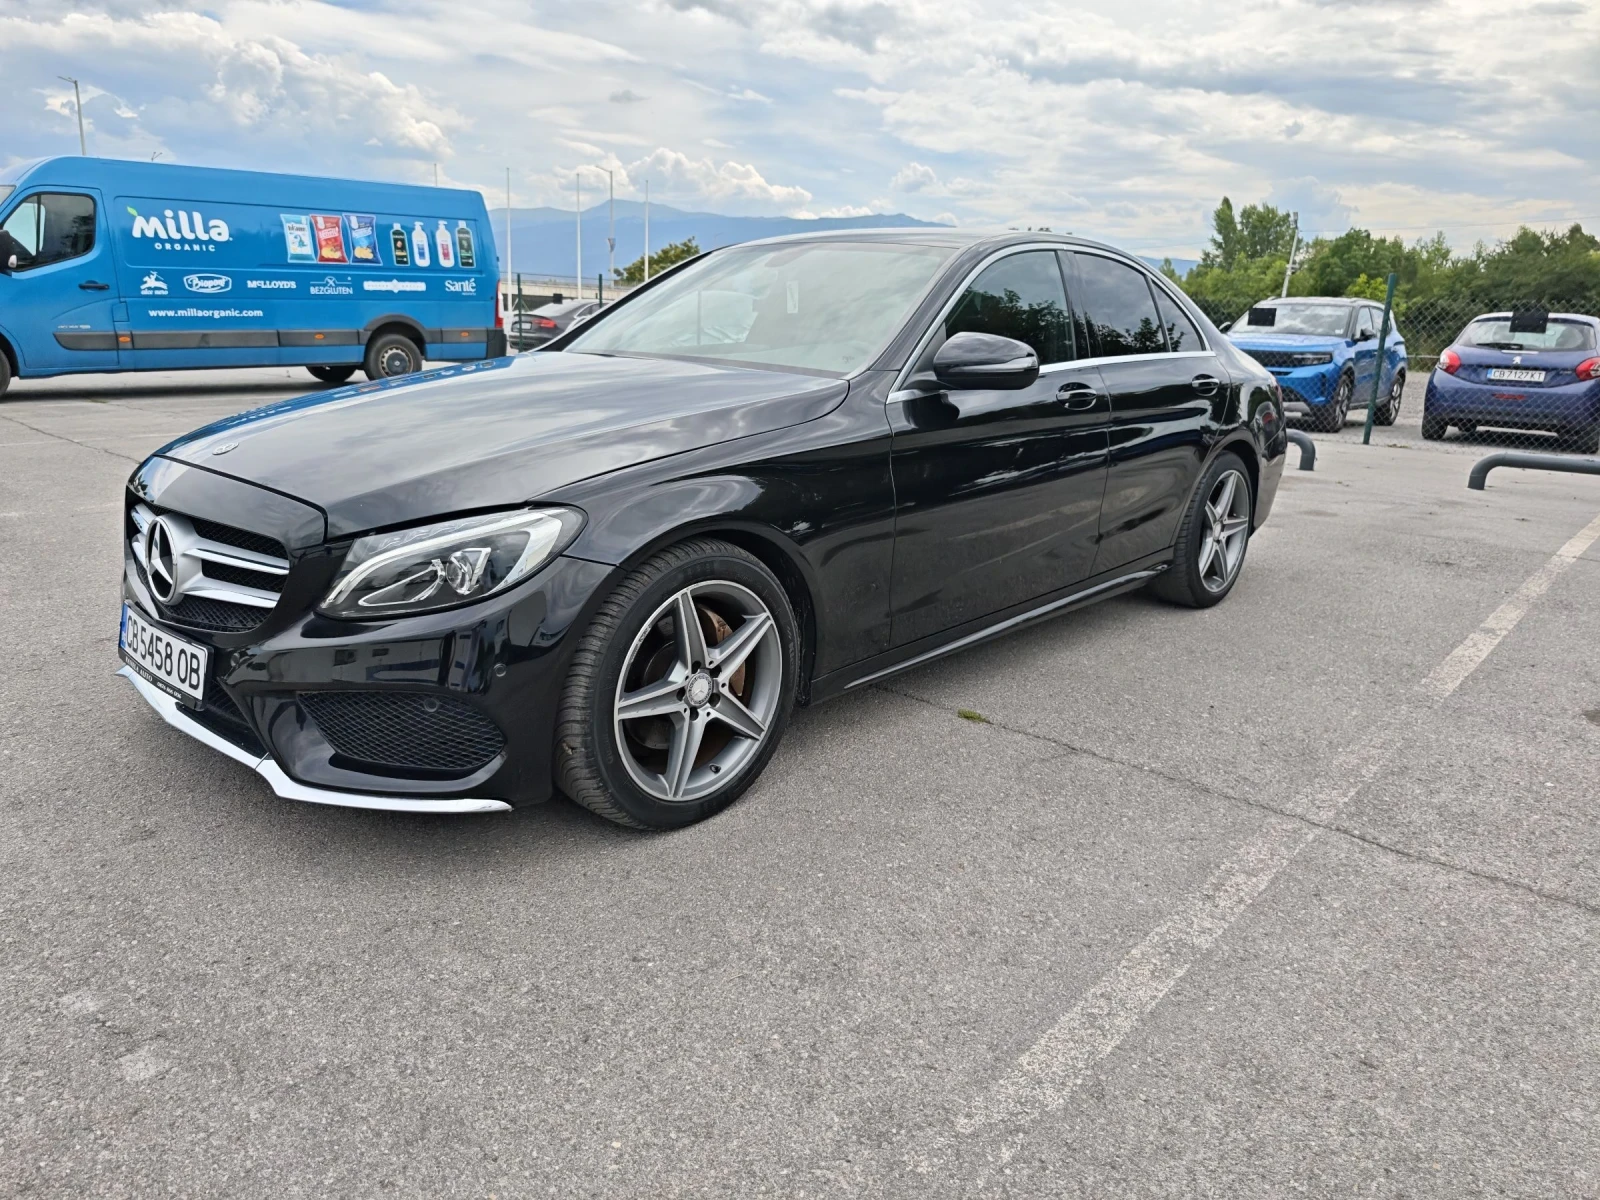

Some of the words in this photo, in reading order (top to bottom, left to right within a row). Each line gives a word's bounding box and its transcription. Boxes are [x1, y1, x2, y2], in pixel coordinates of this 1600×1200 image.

[154, 242, 216, 252] ORGANIC
[445, 277, 476, 292] Santé
[310, 286, 354, 295] BEZGLUTEN
[148, 308, 263, 319] www.millaorganic.com
[1492, 370, 1505, 378] CB
[1507, 371, 1529, 379] 7127
[127, 615, 138, 654] CB
[140, 625, 173, 677] 5458
[178, 648, 200, 690] OB
